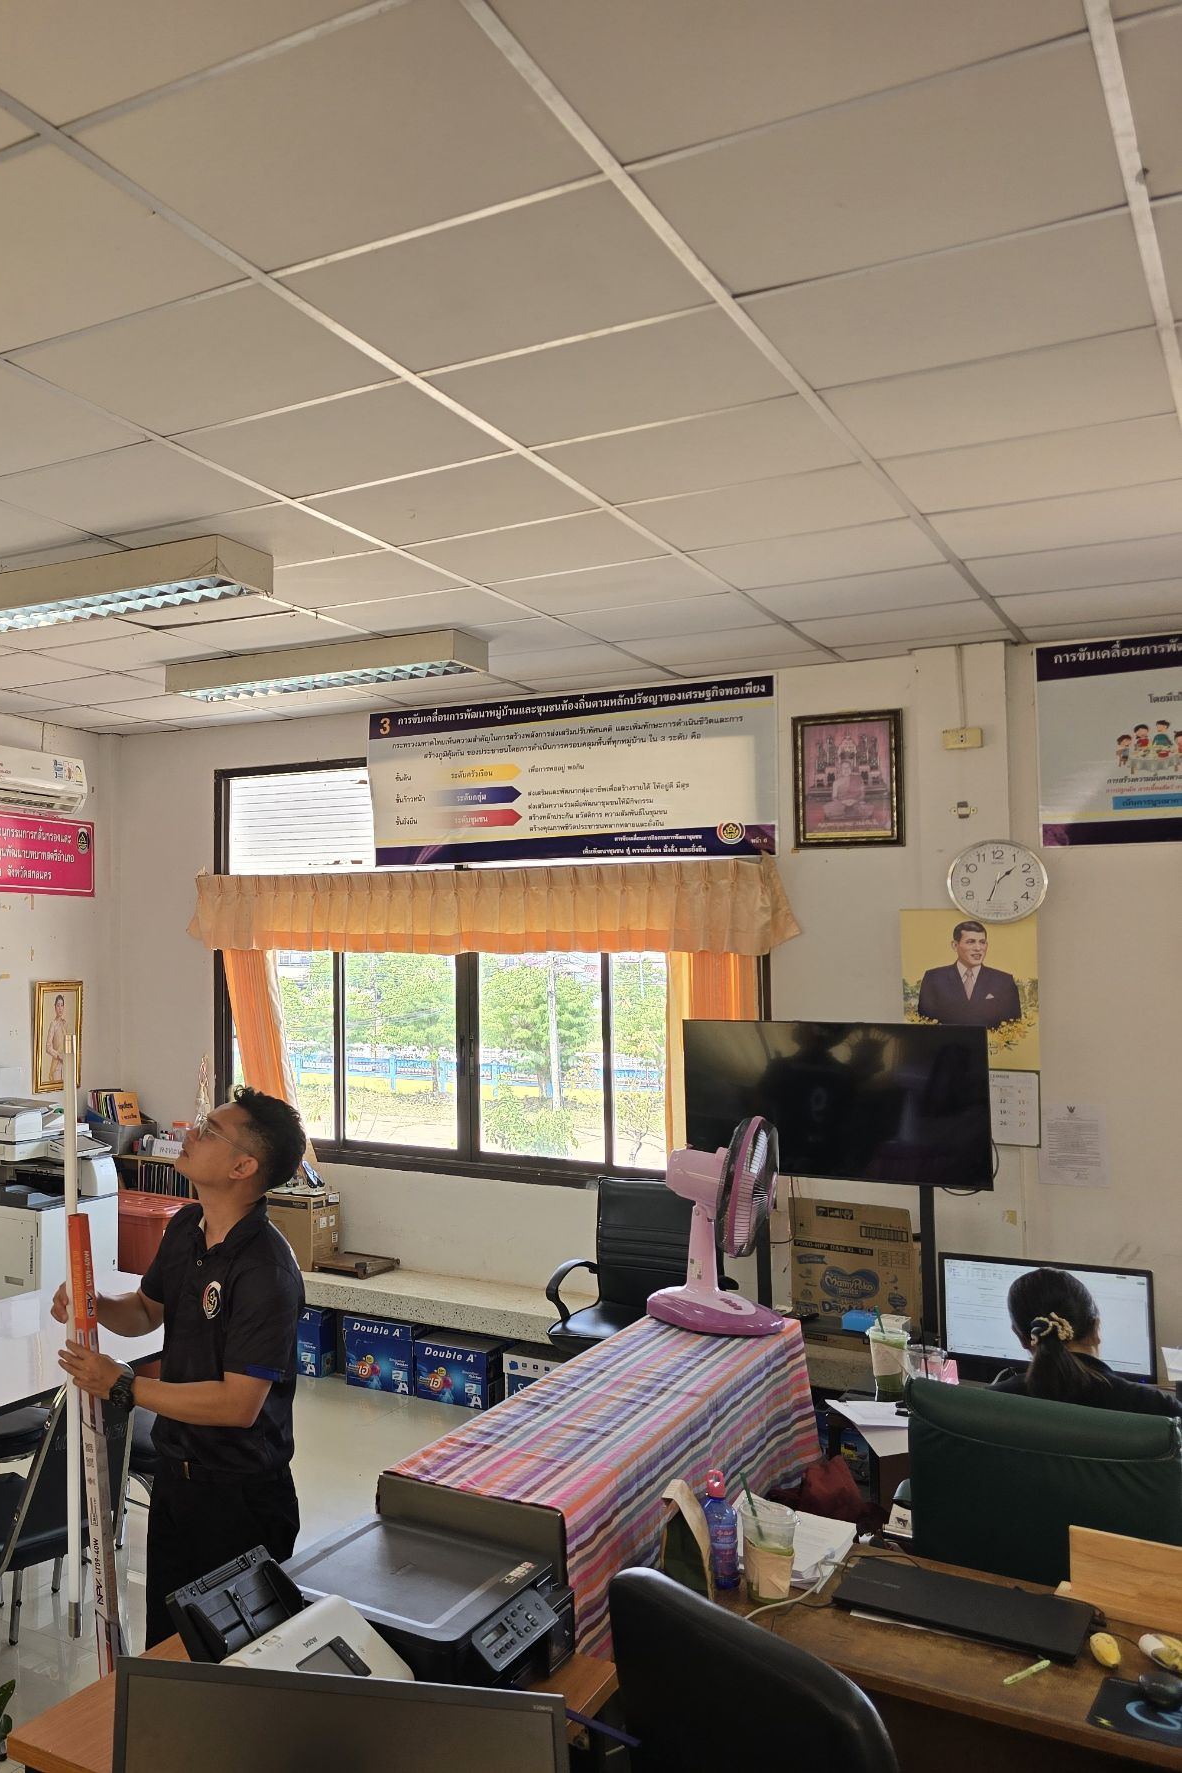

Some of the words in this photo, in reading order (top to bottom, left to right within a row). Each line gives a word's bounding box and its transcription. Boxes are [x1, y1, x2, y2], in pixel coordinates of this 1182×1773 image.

[379, 717, 391, 735] 3
[977, 853, 986, 863] 11
[992, 850, 1004, 860] 12
[1013, 854, 1016, 863] 1
[7, 864, 52, 880] จังหวัดสกลนคร
[965, 864, 978, 873] 10
[1022, 864, 1031, 873] 2
[961, 877, 970, 887] 9
[1026, 878, 1035, 887] 3
[966, 891, 975, 900] 8
[1021, 892, 1030, 901] 4
[353, 1322, 389, 1335] Double
[392, 1328, 400, 1338] A
[424, 1347, 463, 1361] Double
[466, 1354, 474, 1363] A
[93, 1538, 101, 1575] LT09-40W
[96, 1578, 105, 1606] NPV
